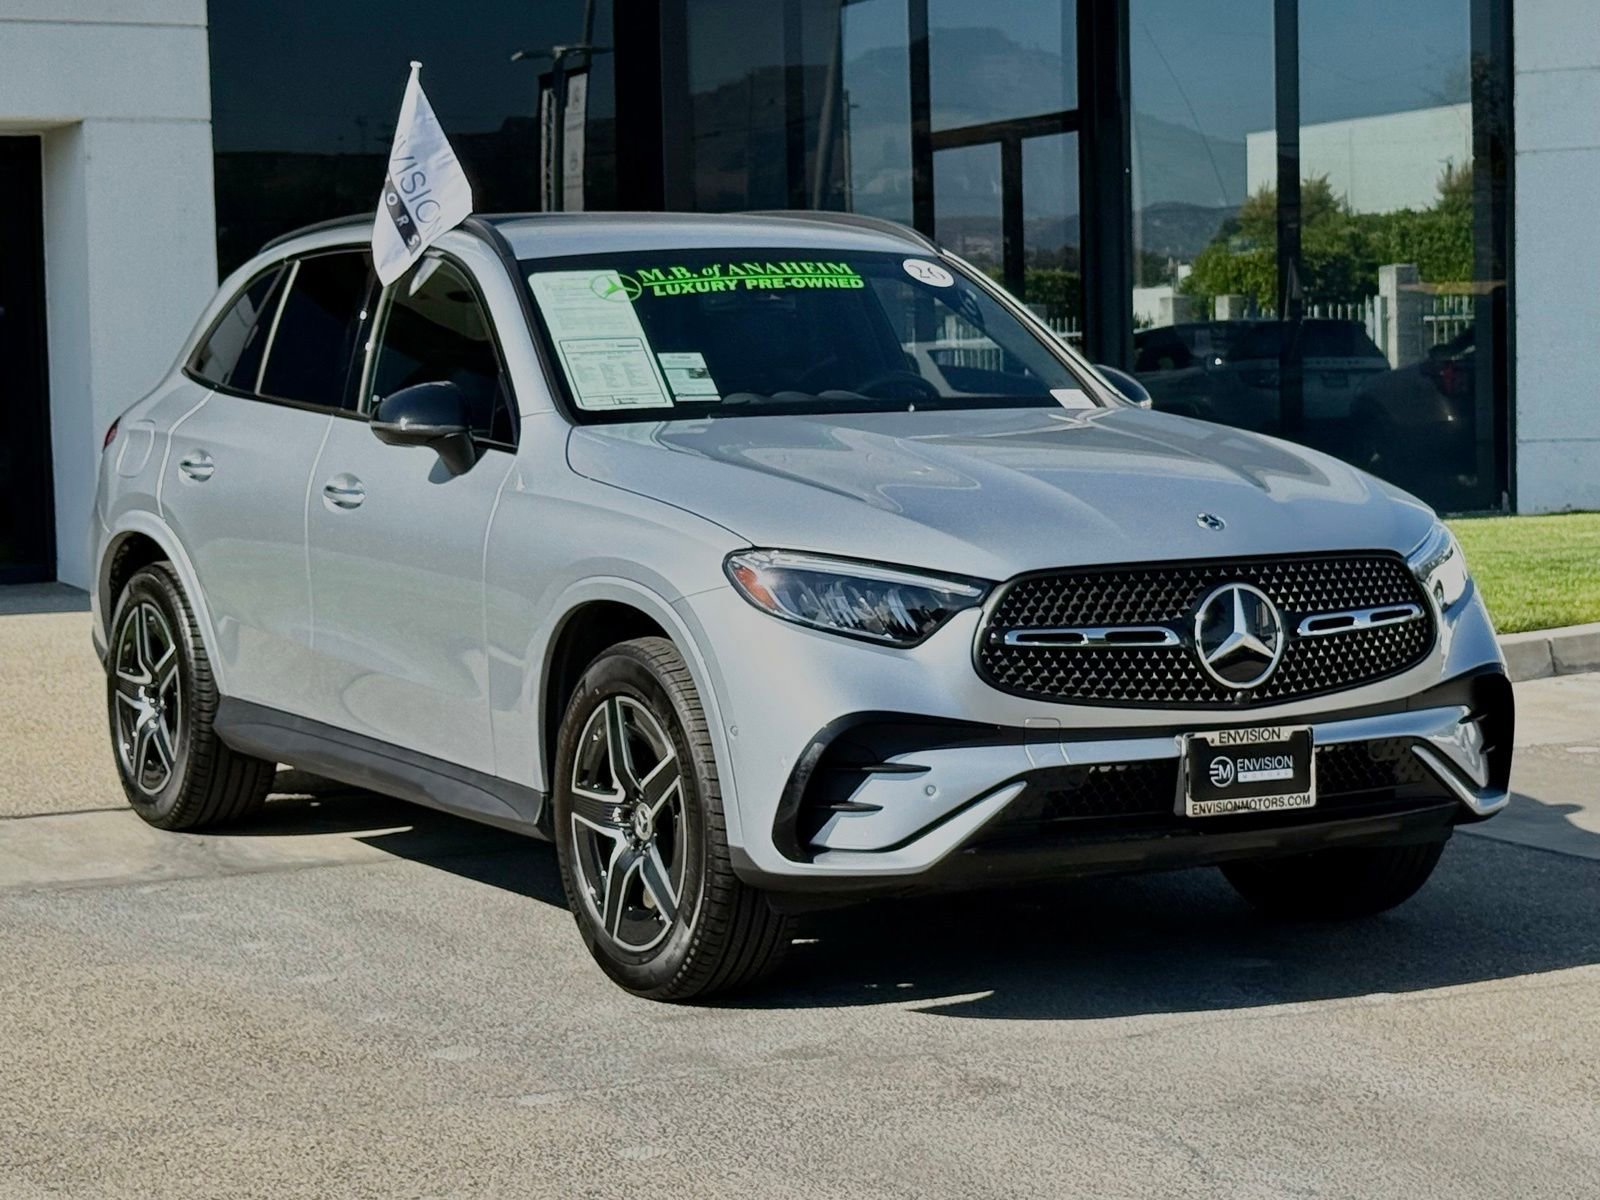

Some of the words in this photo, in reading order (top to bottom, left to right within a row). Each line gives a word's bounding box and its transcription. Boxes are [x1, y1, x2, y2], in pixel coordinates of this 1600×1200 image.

[636, 267, 698, 283] M.B.
[702, 264, 721, 278] of
[729, 262, 855, 276] ANAHEIM
[653, 279, 738, 296] LUXURY
[745, 278, 864, 289] PRE-OWNED
[1219, 728, 1281, 744] ENVISION
[1237, 755, 1293, 771] ENVISION
[1192, 795, 1310, 815] ENVISIONMOTORS.COM
